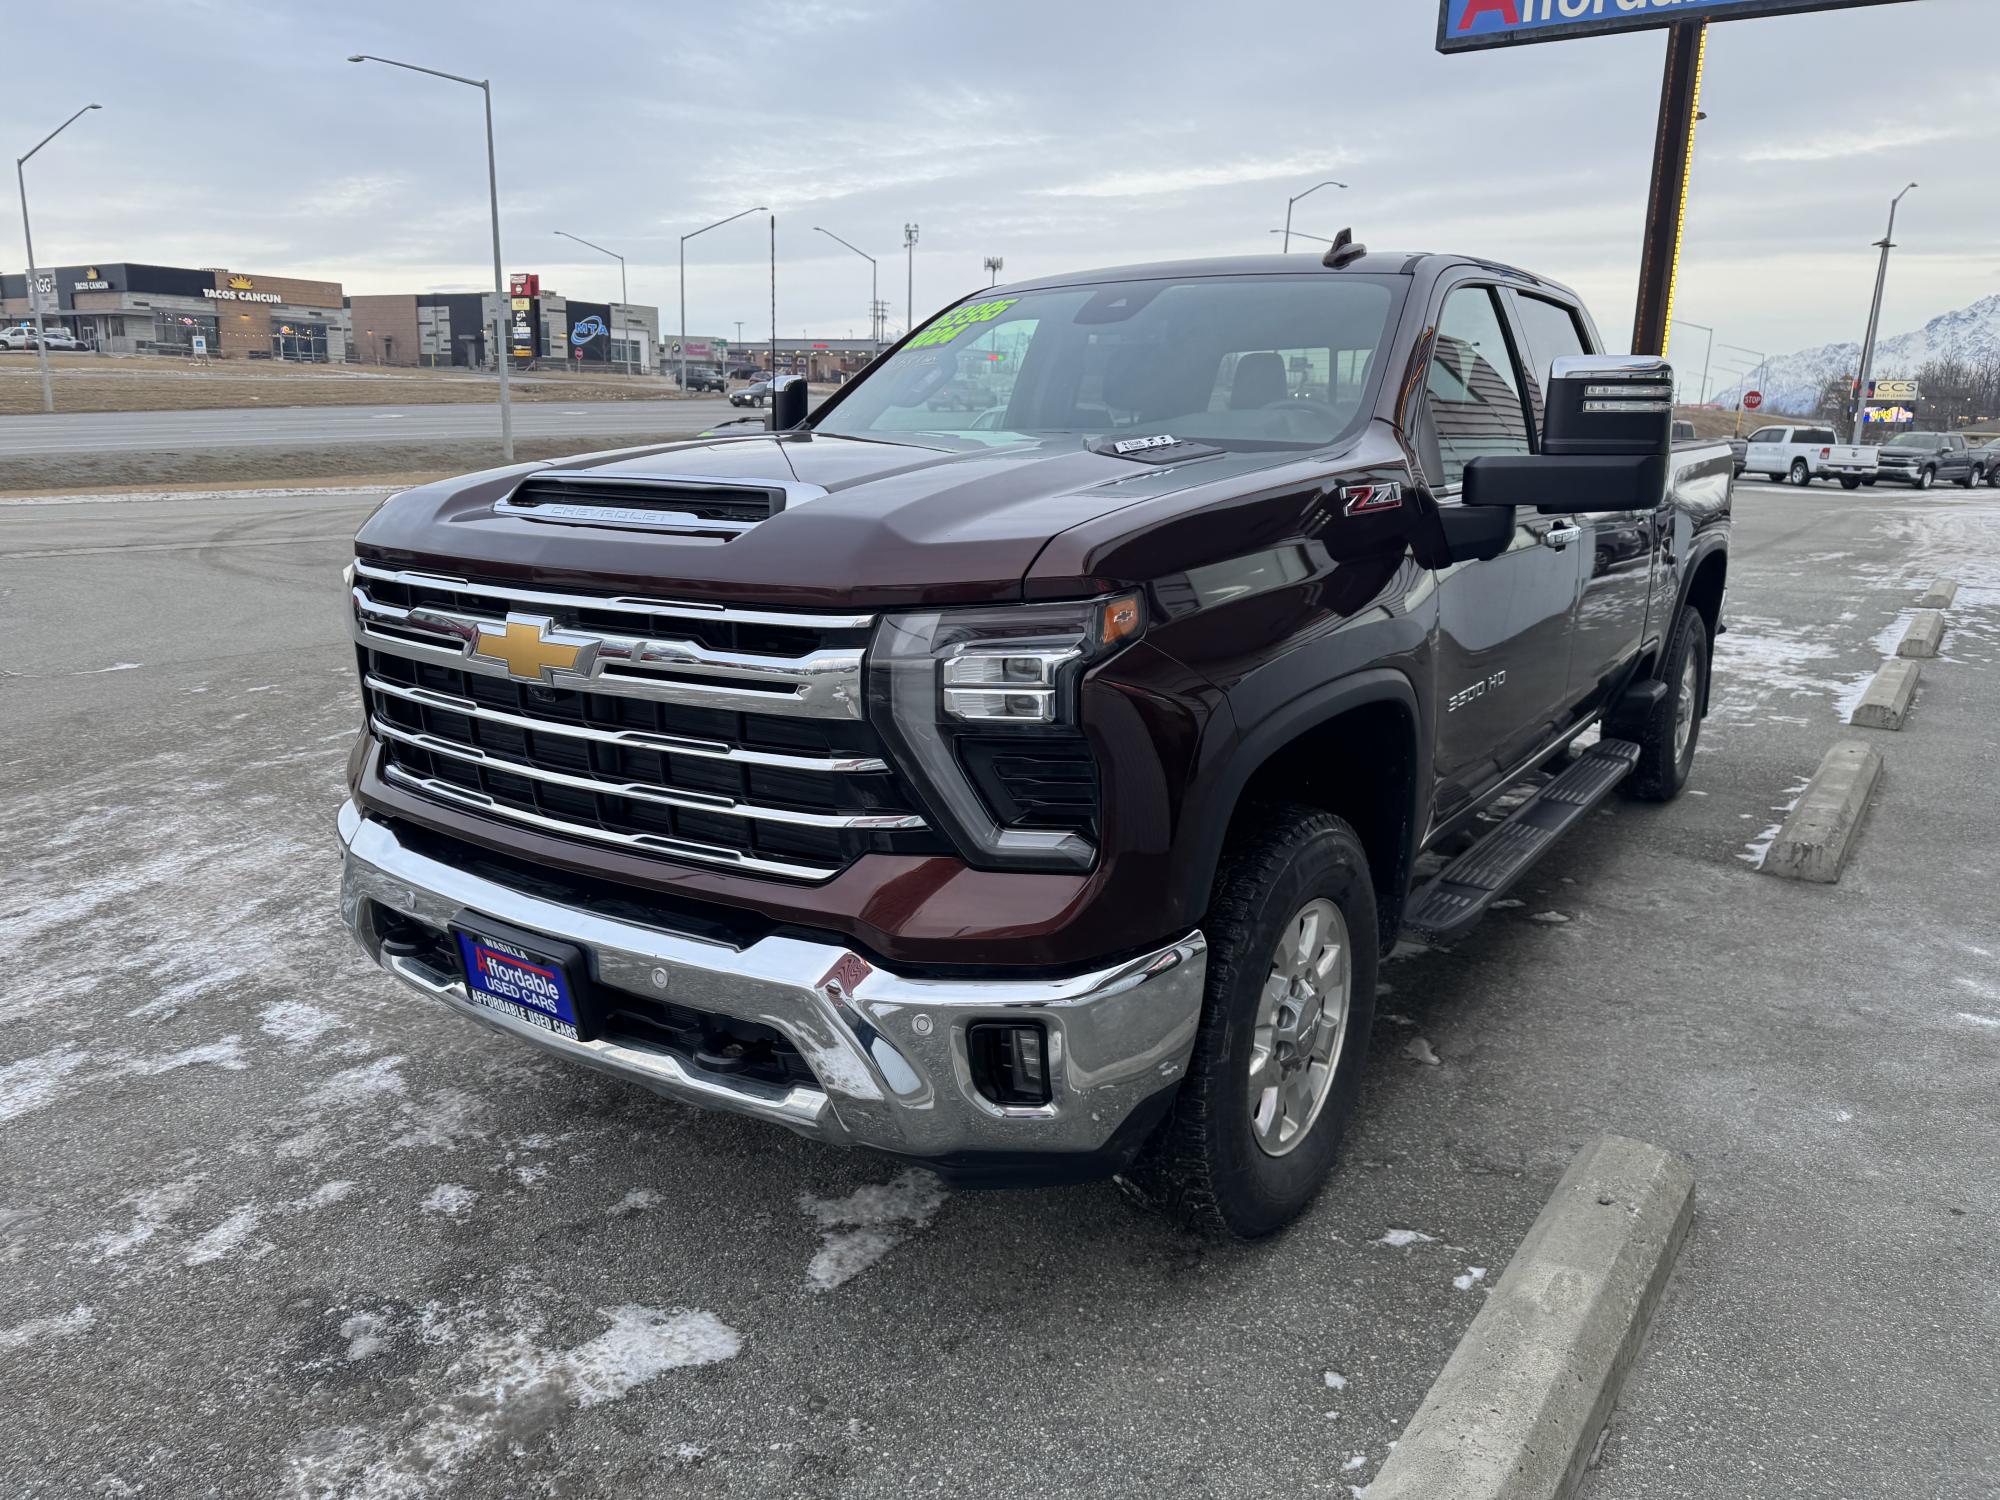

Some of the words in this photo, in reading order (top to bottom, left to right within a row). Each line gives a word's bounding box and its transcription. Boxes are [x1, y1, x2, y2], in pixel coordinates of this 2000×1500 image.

[74, 281, 89, 290] TACOS
[89, 280, 109, 289] CANCUN
[202, 288, 237, 301] TACOS
[238, 291, 282, 304] CANCUN
[574, 322, 609, 337] MTA
[1877, 382, 1917, 392] CCS
[1744, 395, 1762, 404] STOP
[1340, 482, 1402, 517] Z71
[550, 505, 673, 523] CHEVROLET
[1487, 670, 1507, 692] HD
[482, 936, 529, 961] WASILLA
[475, 946, 560, 1000] Affordable
[484, 975, 520, 999] USED
[521, 989, 558, 1014] CARS
[471, 989, 528, 1020] AFFORDABLE
[527, 1010, 553, 1031] USED
[553, 1020, 579, 1041] CARS
